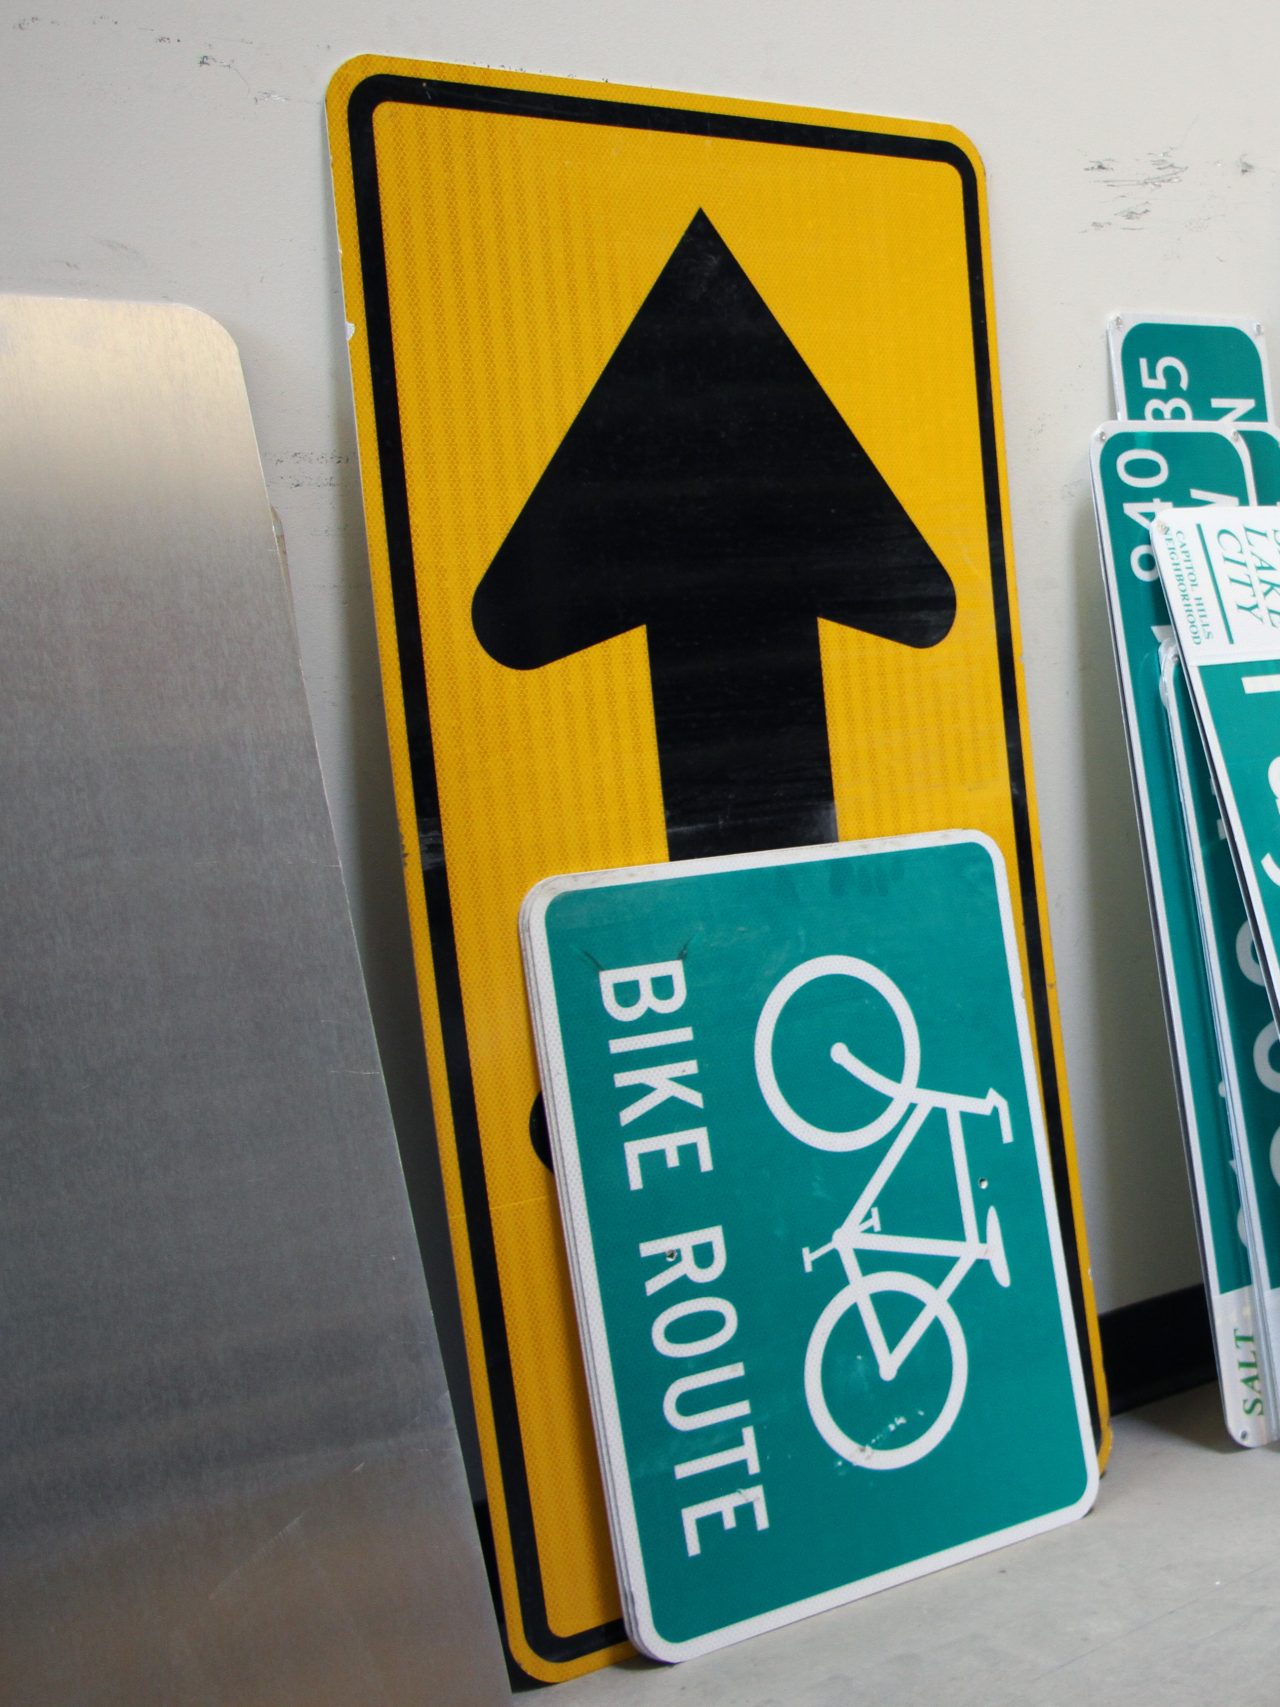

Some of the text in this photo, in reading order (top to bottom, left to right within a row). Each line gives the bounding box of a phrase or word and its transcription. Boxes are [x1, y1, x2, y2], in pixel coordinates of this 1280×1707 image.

[1162, 525, 1202, 645] NEIGHBORHOOD
[1176, 530, 1213, 640] CAPITOL HILLS
[1216, 528, 1264, 624] CITY
[598, 959, 770, 1557] BIKE ROUTE
[1234, 1328, 1264, 1417] SALT
